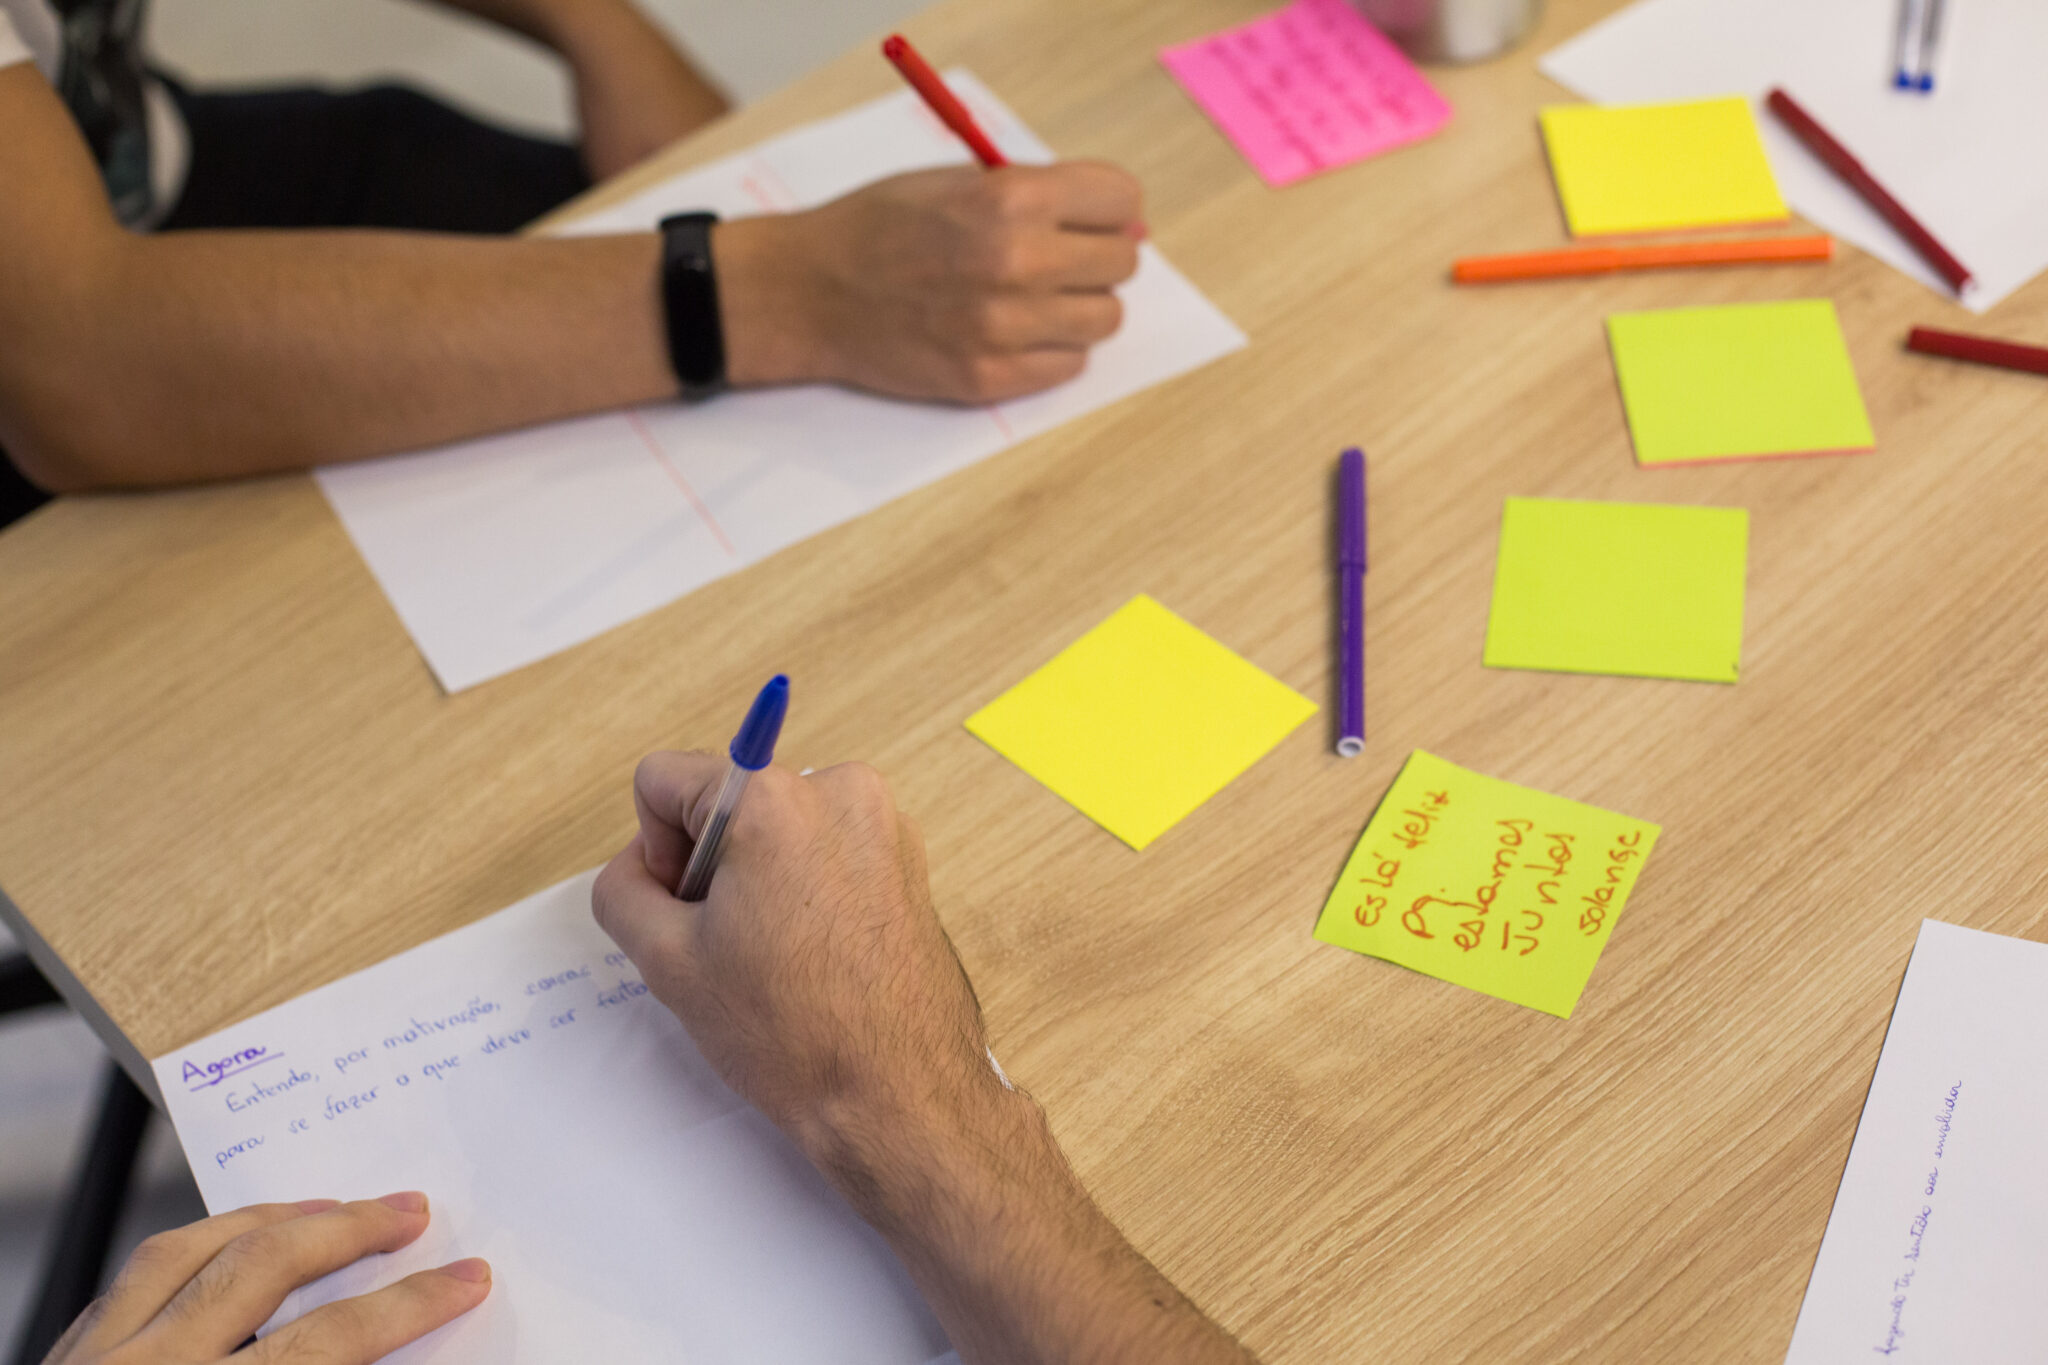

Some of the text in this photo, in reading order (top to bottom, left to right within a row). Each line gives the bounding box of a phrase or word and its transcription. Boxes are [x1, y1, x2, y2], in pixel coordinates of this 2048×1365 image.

[1392, 791, 1449, 849] feliz
[1452, 819, 1534, 952] estamos
[181, 1046, 268, 1088] Agora
[334, 1047, 369, 1074] por
[604, 951, 629, 968] qu
[215, 1135, 266, 1169] para
[288, 1117, 310, 1134] se
[323, 1086, 379, 1121] fazer
[396, 1073, 410, 1086] o
[423, 1055, 461, 1081] que
[480, 1028, 532, 1054] deve
[550, 1008, 577, 1029] ser
